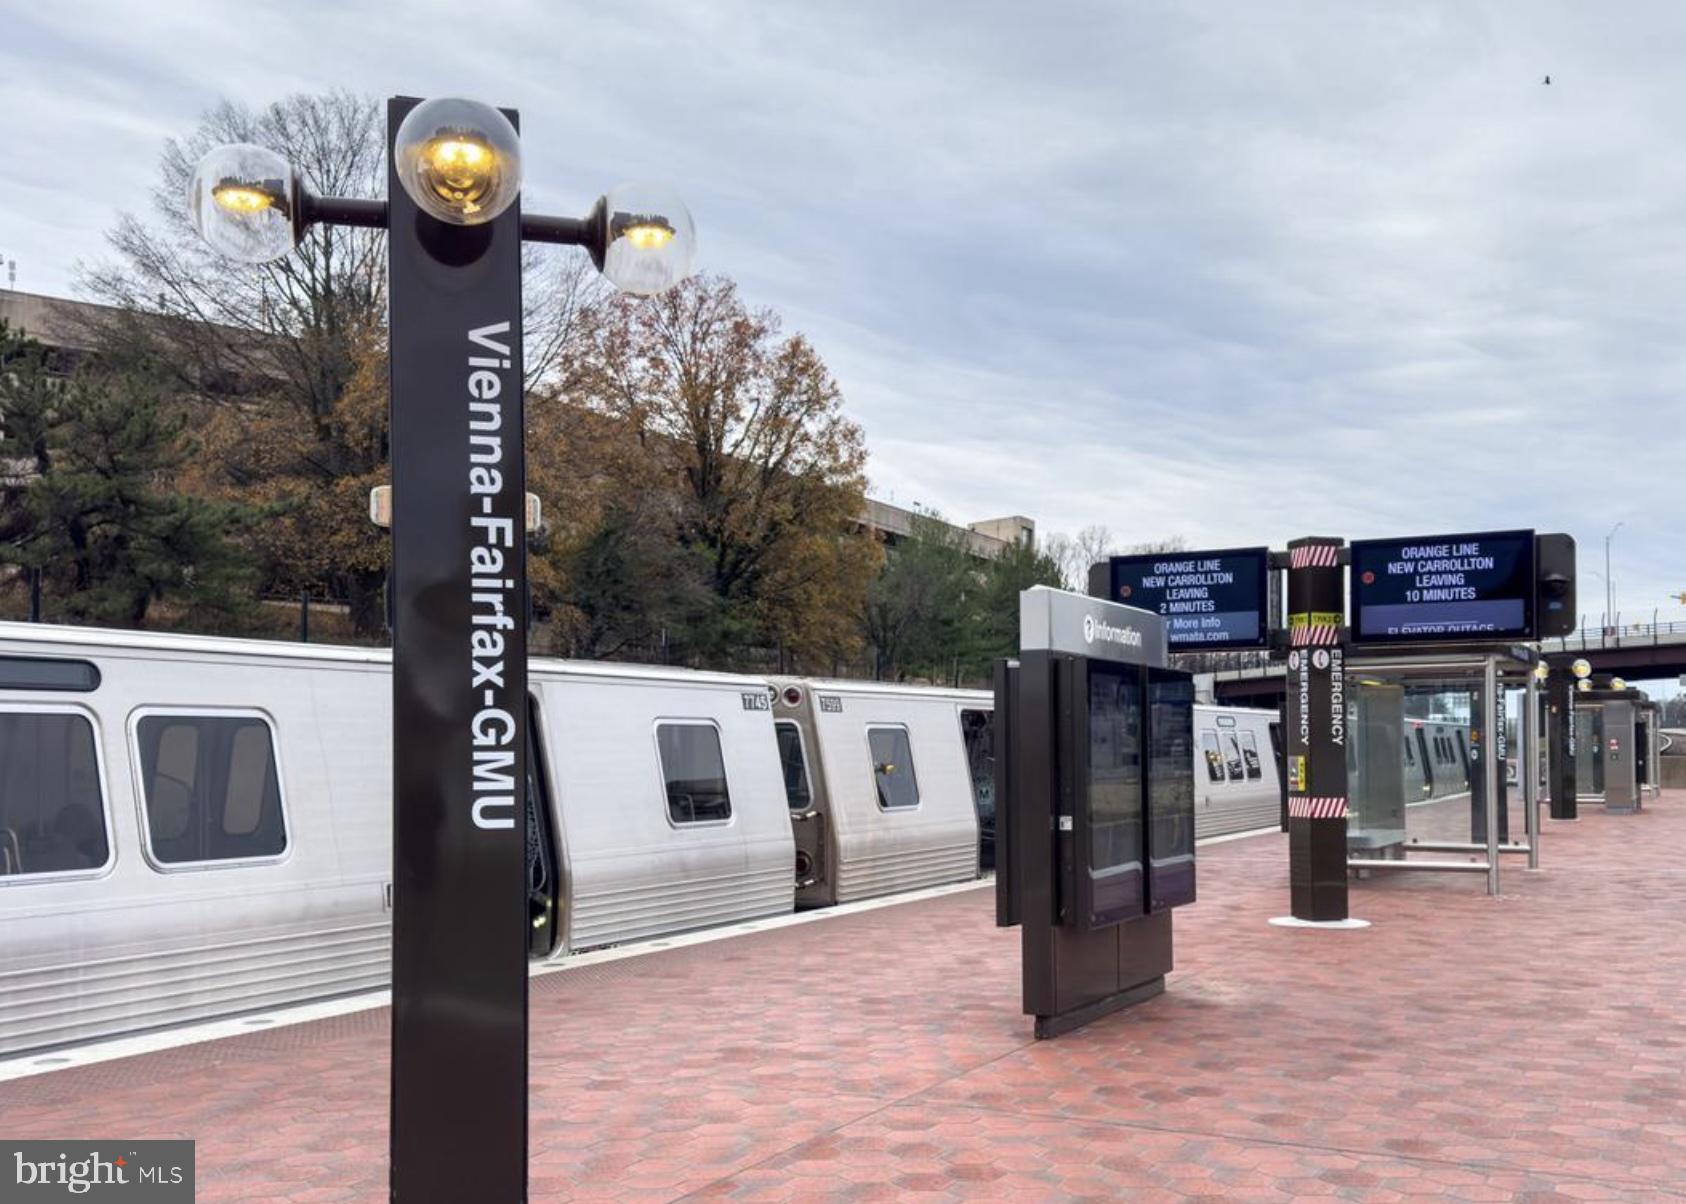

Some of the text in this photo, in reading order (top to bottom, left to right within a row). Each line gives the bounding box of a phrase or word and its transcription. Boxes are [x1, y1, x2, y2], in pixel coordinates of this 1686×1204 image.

[1402, 543, 1480, 559] ORANGE LINE
[1154, 559, 1221, 574] ORANGE LINE
[1388, 557, 1494, 574] NEW CARROLLTON
[467, 320, 517, 830] Vienna-Fairfax-GMU
[1142, 572, 1233, 588] NEW CARROLLTON
[1416, 573, 1465, 587] LEAVING
[1166, 586, 1208, 600] LEAVING
[1406, 587, 1476, 602] 10 MINUTES
[1160, 600, 1215, 614] 2 MINUTES
[1173, 617, 1199, 630] More
[1201, 615, 1221, 628] Info
[1300, 649, 1309, 746] EMERGENCY
[1330, 648, 1343, 746] EMERGENCY
